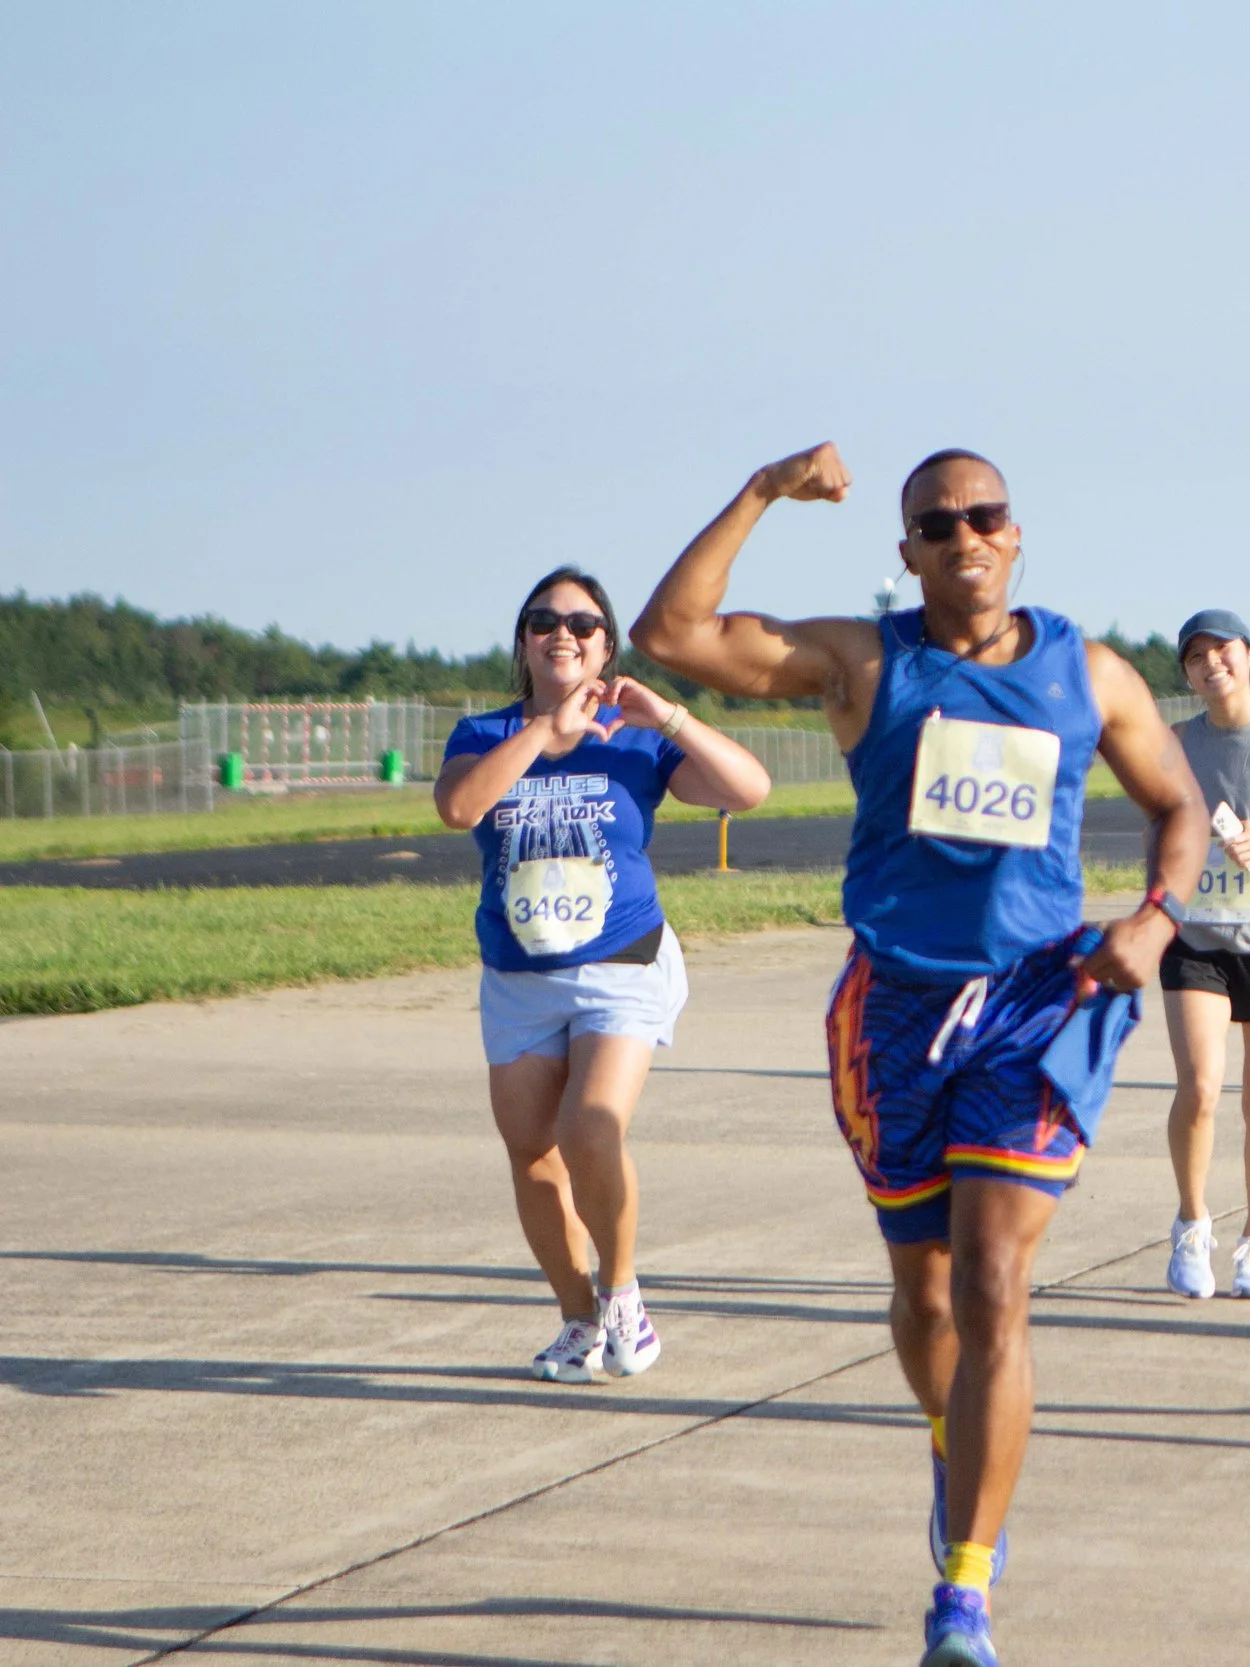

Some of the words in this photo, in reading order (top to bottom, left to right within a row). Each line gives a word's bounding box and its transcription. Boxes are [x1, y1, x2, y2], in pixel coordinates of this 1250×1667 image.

[925, 773, 1038, 821] 4026
[495, 808, 540, 829] 5K
[560, 801, 616, 823] 10K
[1197, 870, 1245, 895] 011
[514, 895, 594, 924] 3462
